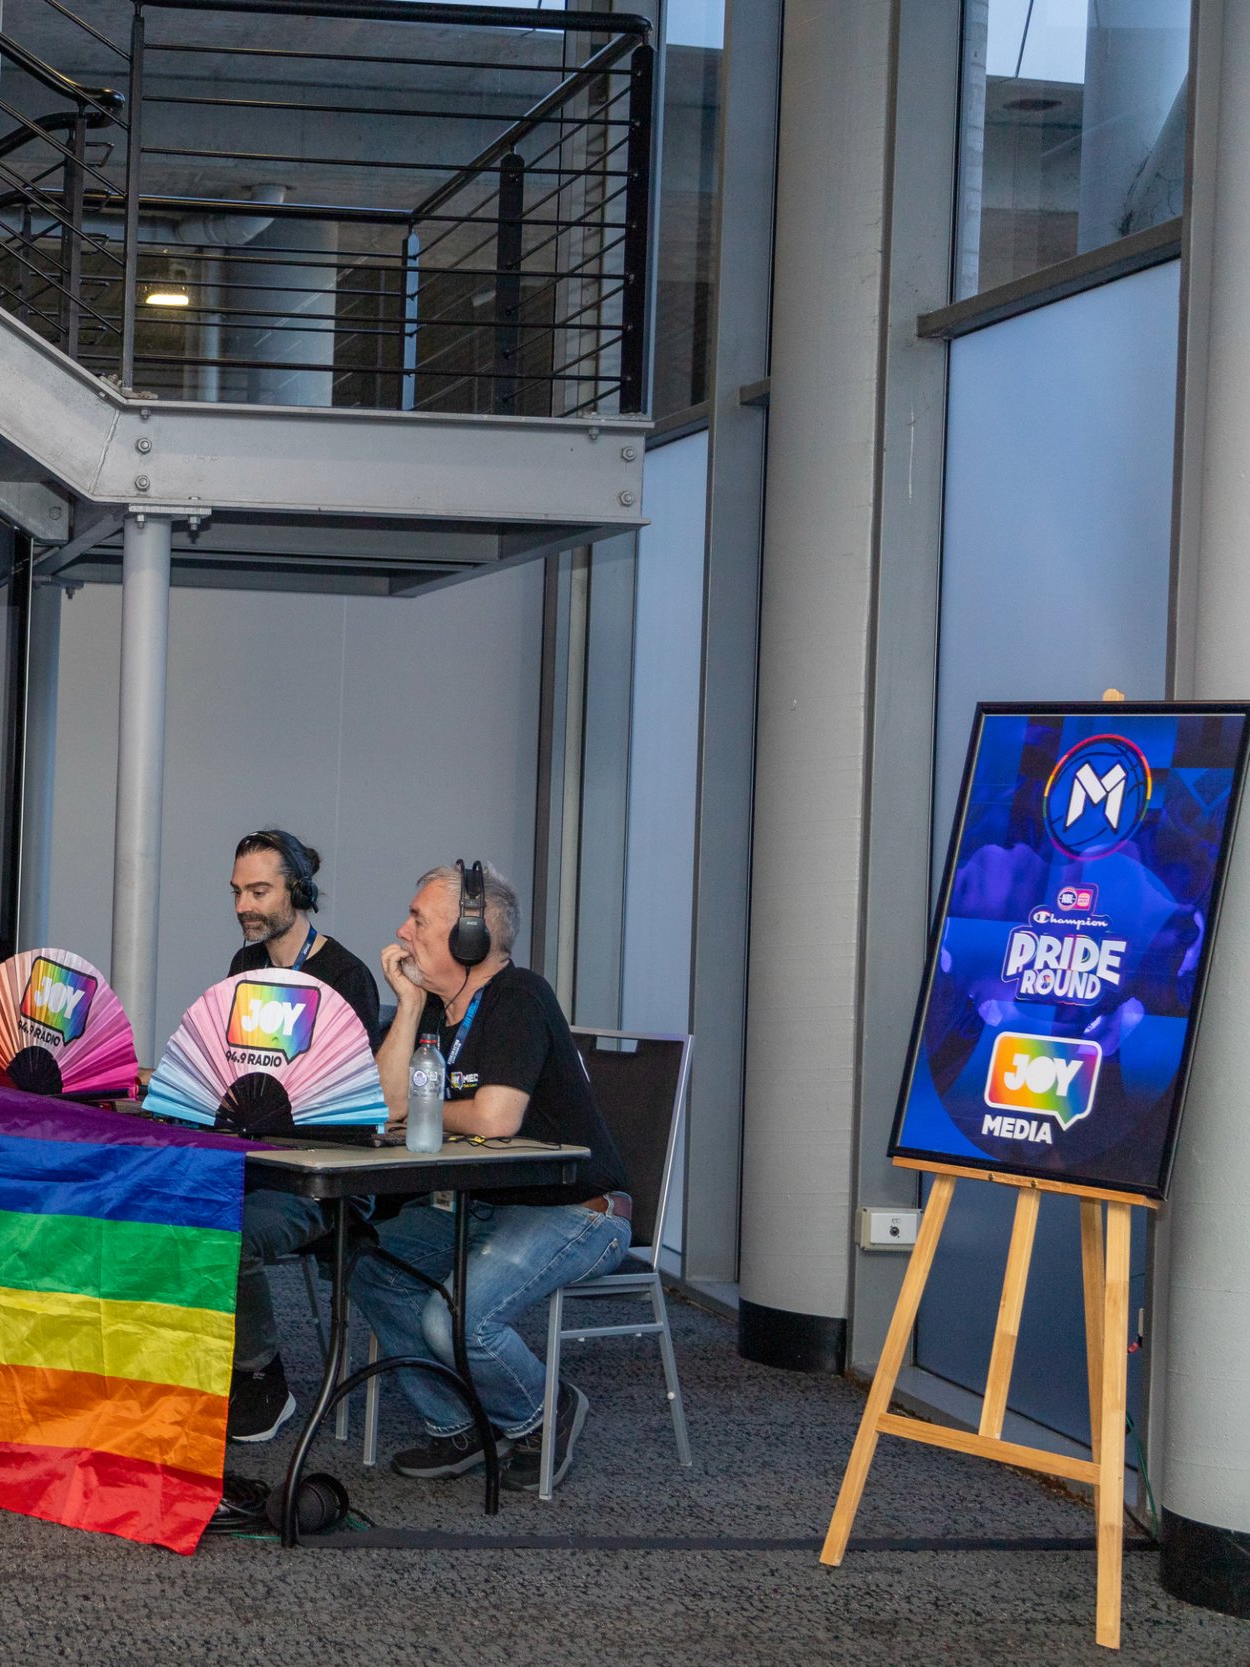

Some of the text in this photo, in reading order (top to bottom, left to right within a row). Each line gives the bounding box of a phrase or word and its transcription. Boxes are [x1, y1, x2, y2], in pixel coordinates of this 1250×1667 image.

[1033, 911, 1109, 931] Champion
[1006, 931, 1127, 986] PRIDE
[34, 975, 86, 1018] JOY
[1019, 970, 1101, 1001] ROUND
[241, 999, 307, 1036] JOY
[34, 1028, 61, 1047] RADIO
[225, 1050, 282, 1067] 94.9 RADIO
[1004, 1054, 1084, 1097] JOY
[981, 1114, 1053, 1145] MEDIA
